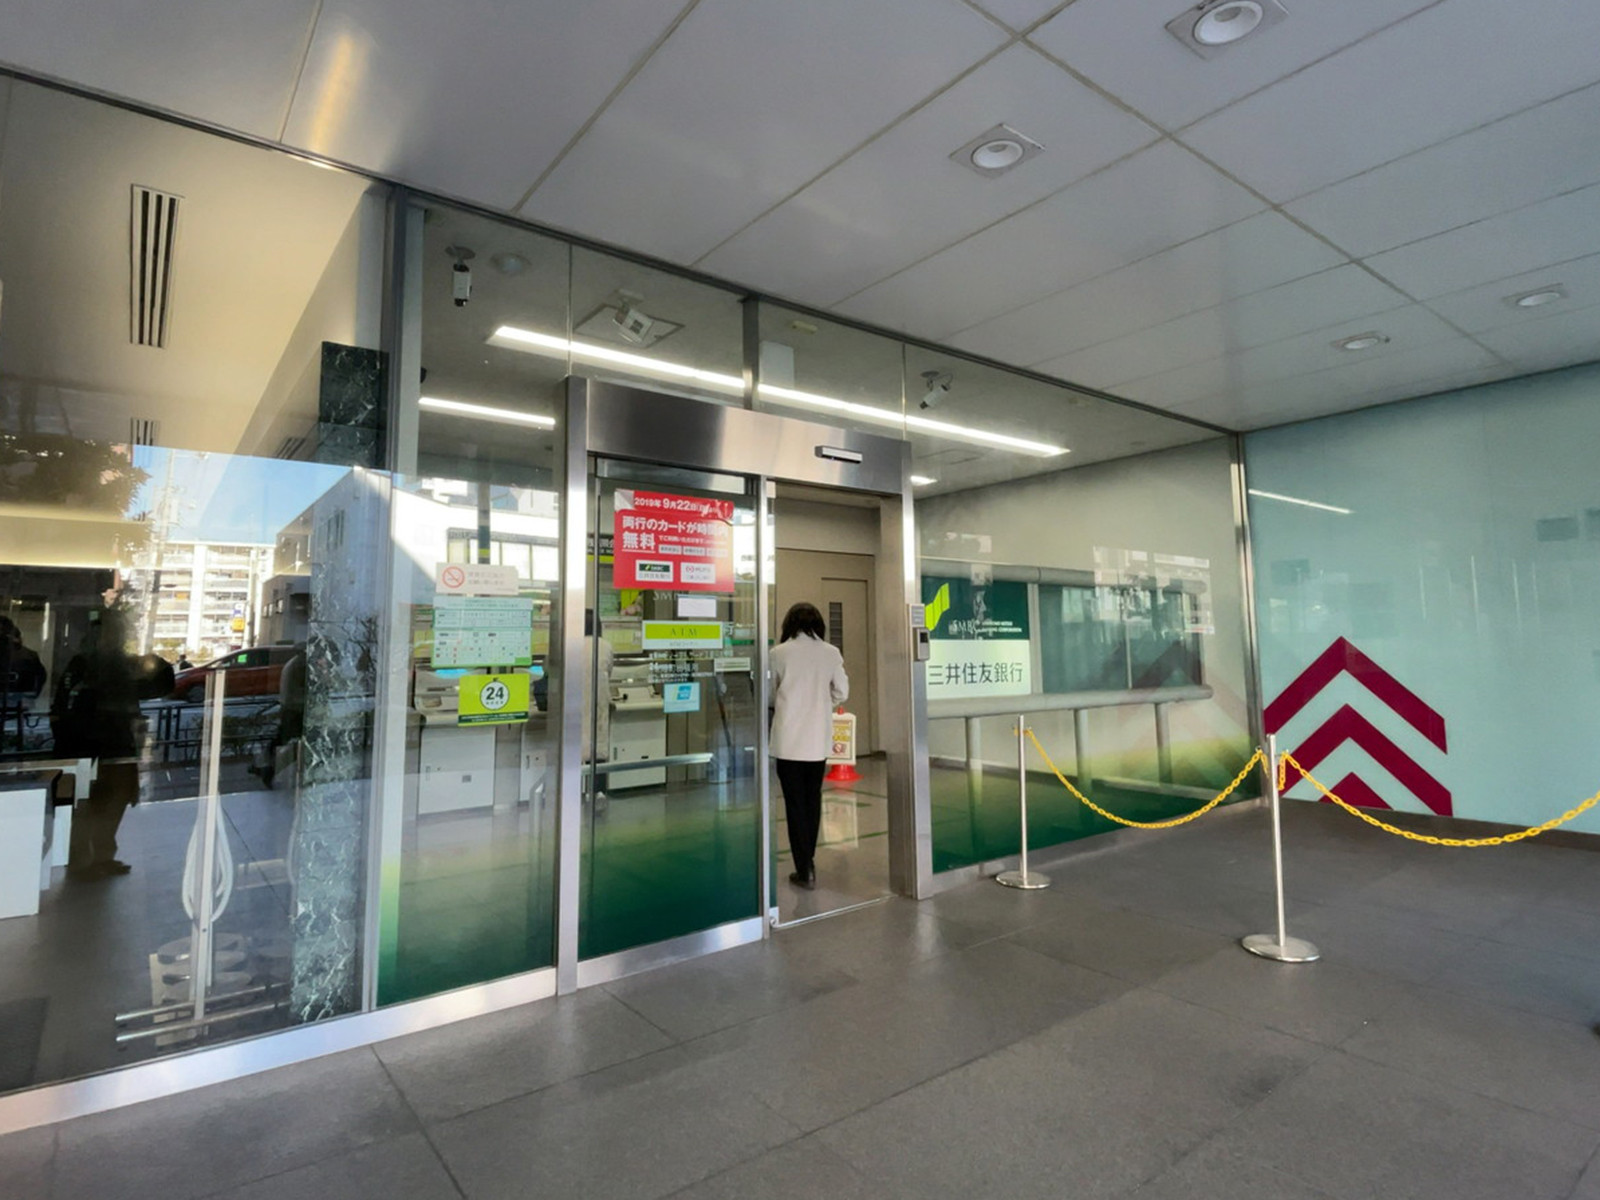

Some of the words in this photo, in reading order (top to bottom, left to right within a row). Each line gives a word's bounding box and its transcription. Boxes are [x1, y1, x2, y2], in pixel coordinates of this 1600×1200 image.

[622, 530, 656, 550] 無料
[928, 662, 1024, 685] 三井住友銀行
[485, 686, 505, 700] 24
